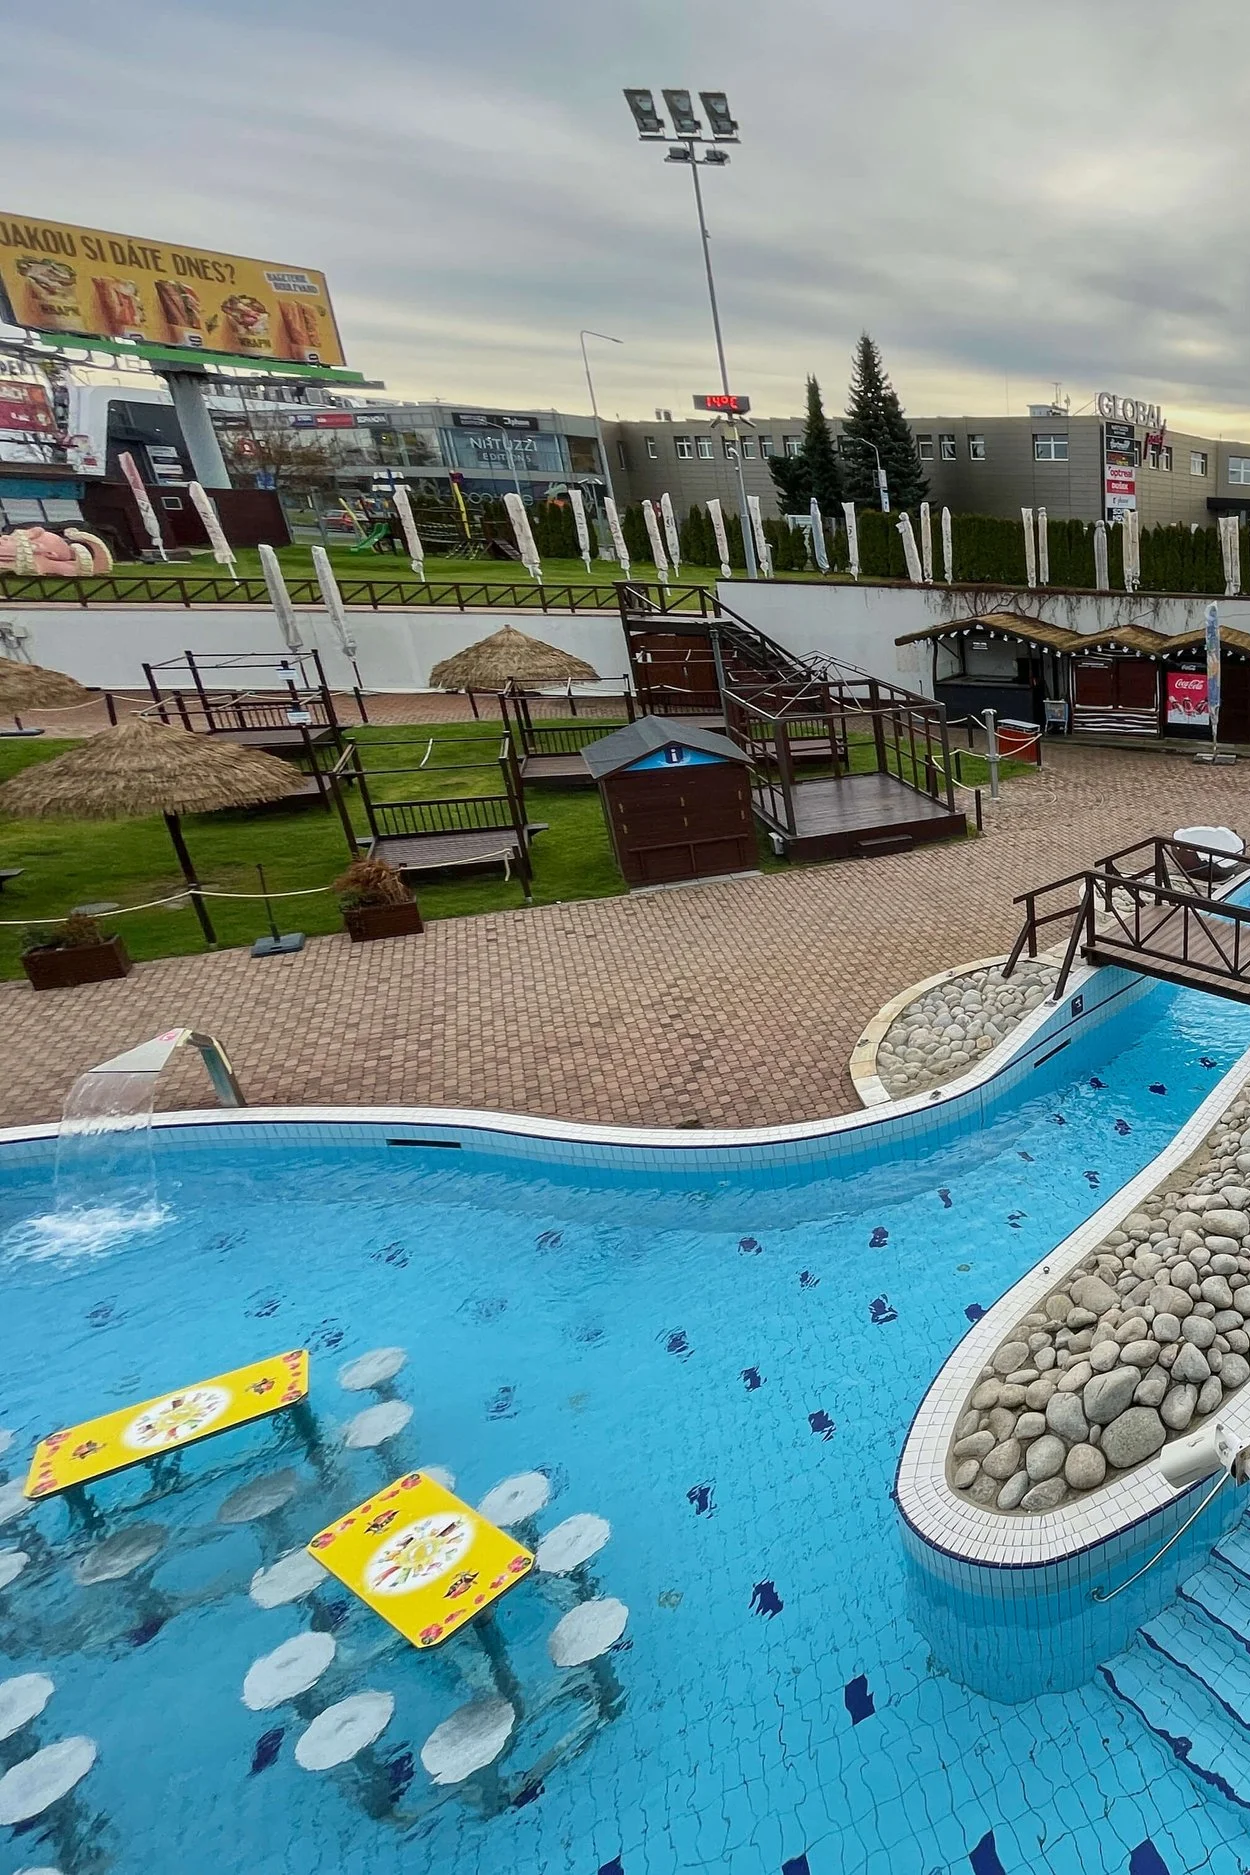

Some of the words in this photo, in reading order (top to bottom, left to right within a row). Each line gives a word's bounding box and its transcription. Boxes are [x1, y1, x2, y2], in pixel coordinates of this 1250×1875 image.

[0, 221, 77, 257] JAKOU
[80, 235, 107, 262] SI
[108, 239, 167, 273] DÁTE
[172, 253, 236, 285] DNES?
[1098, 392, 1161, 428] GLOBAL
[469, 436, 537, 452] NATUZZI
[482, 452, 532, 463] EDITONS
